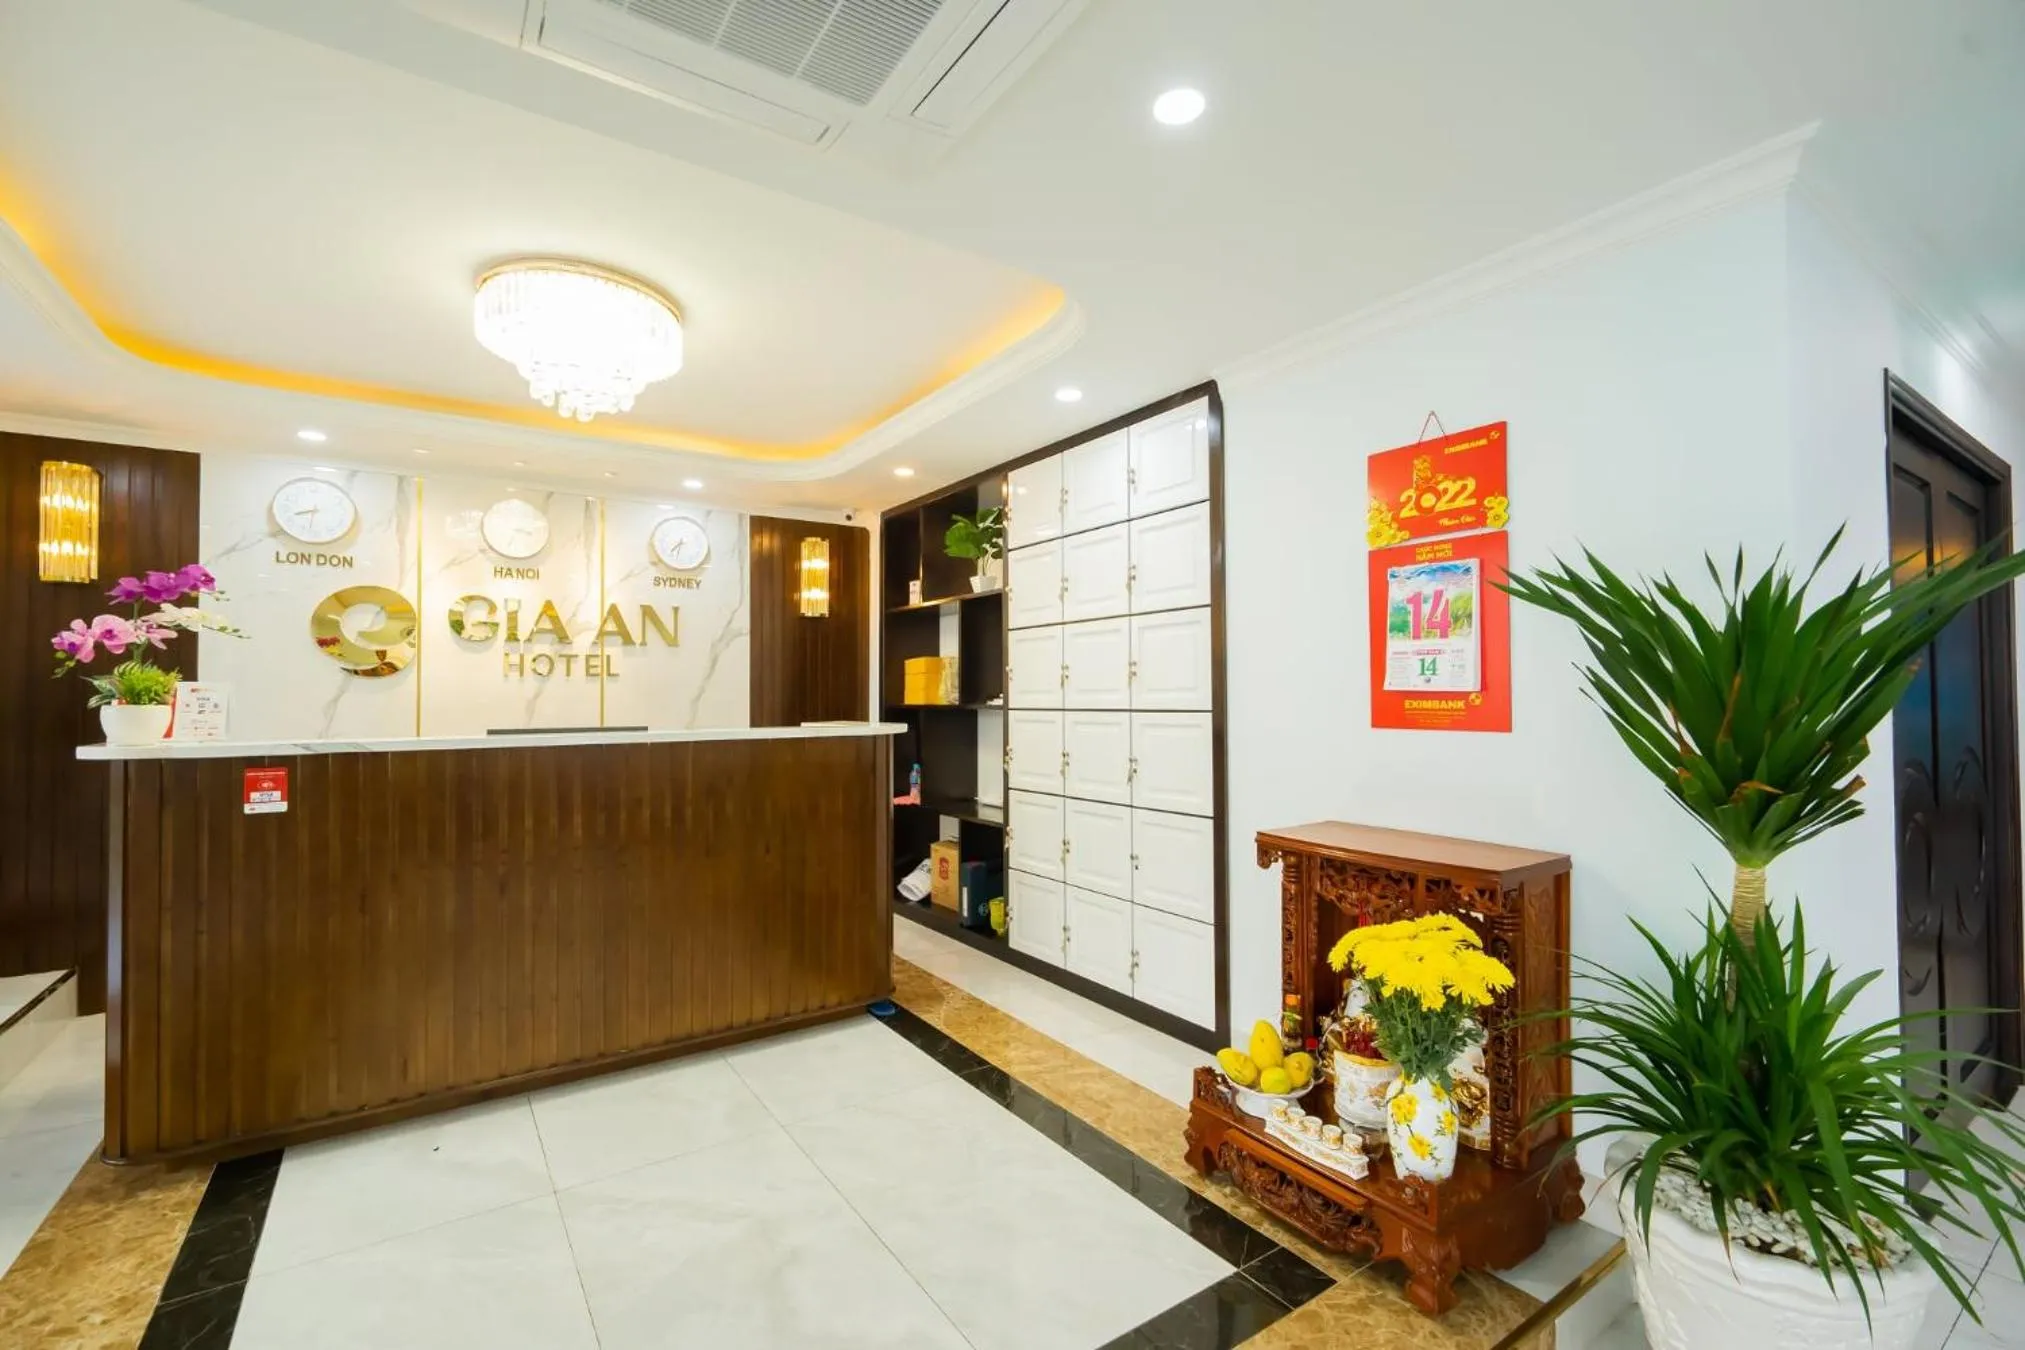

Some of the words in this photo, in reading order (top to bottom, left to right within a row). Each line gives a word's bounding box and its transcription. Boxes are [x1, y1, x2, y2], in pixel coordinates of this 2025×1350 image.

[1399, 476, 1478, 519] 2022
[493, 566, 541, 581] HANOI
[653, 575, 703, 590] SYDNEY
[448, 594, 573, 645] GIA
[591, 602, 681, 648] AN
[1405, 588, 1453, 641] 14
[503, 652, 621, 678] HOTEL
[1417, 657, 1440, 676] 14
[1404, 699, 1467, 710] EXIMBANK
